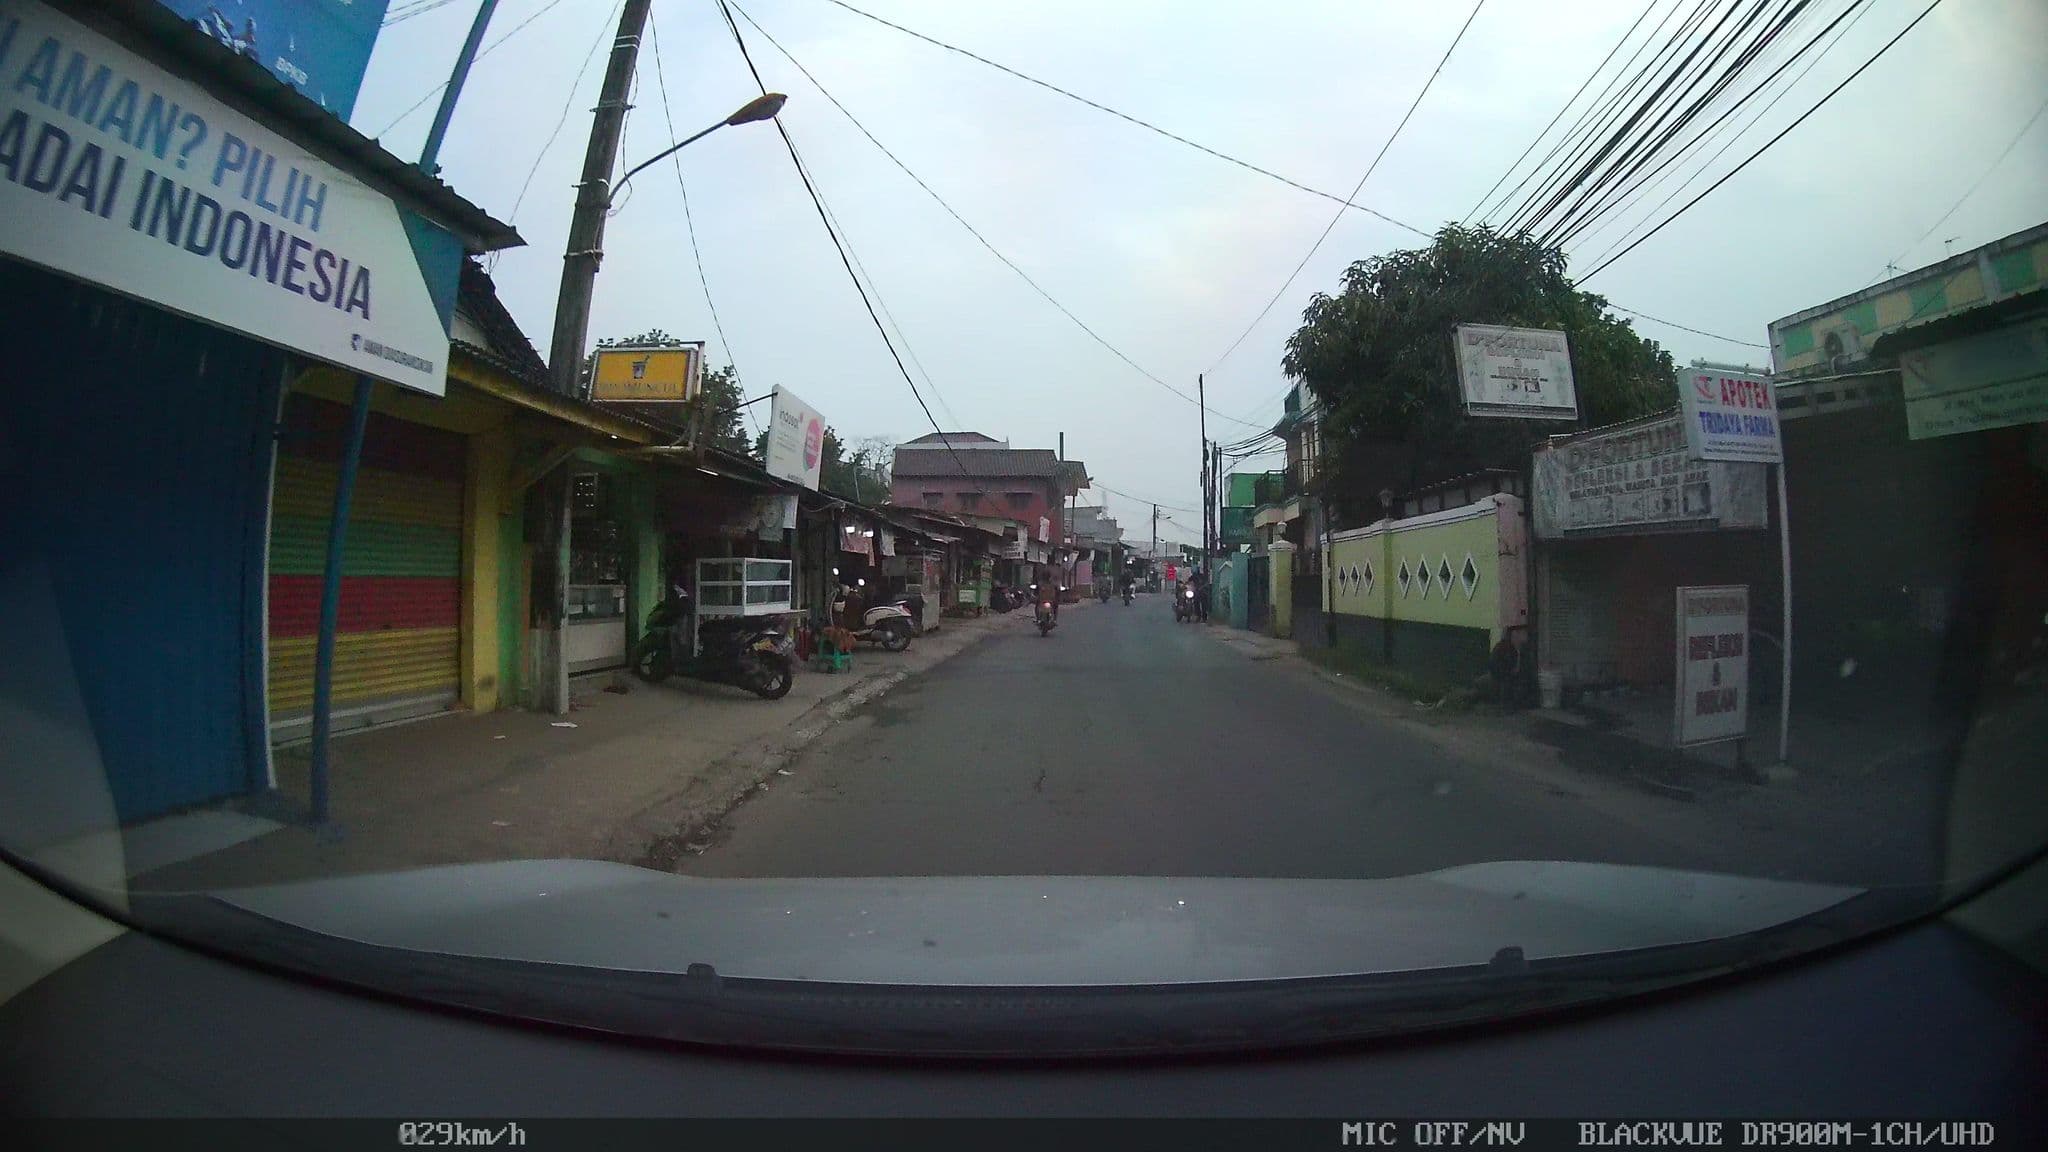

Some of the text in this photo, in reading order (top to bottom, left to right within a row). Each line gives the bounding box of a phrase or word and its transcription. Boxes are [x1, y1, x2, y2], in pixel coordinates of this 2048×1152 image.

[17, 37, 208, 169] AMAN?
[211, 132, 328, 233] PILIH
[130, 170, 372, 320] INDONESIA
[1719, 377, 1773, 410] APOTEK
[1743, 413, 1777, 439] FARMA
